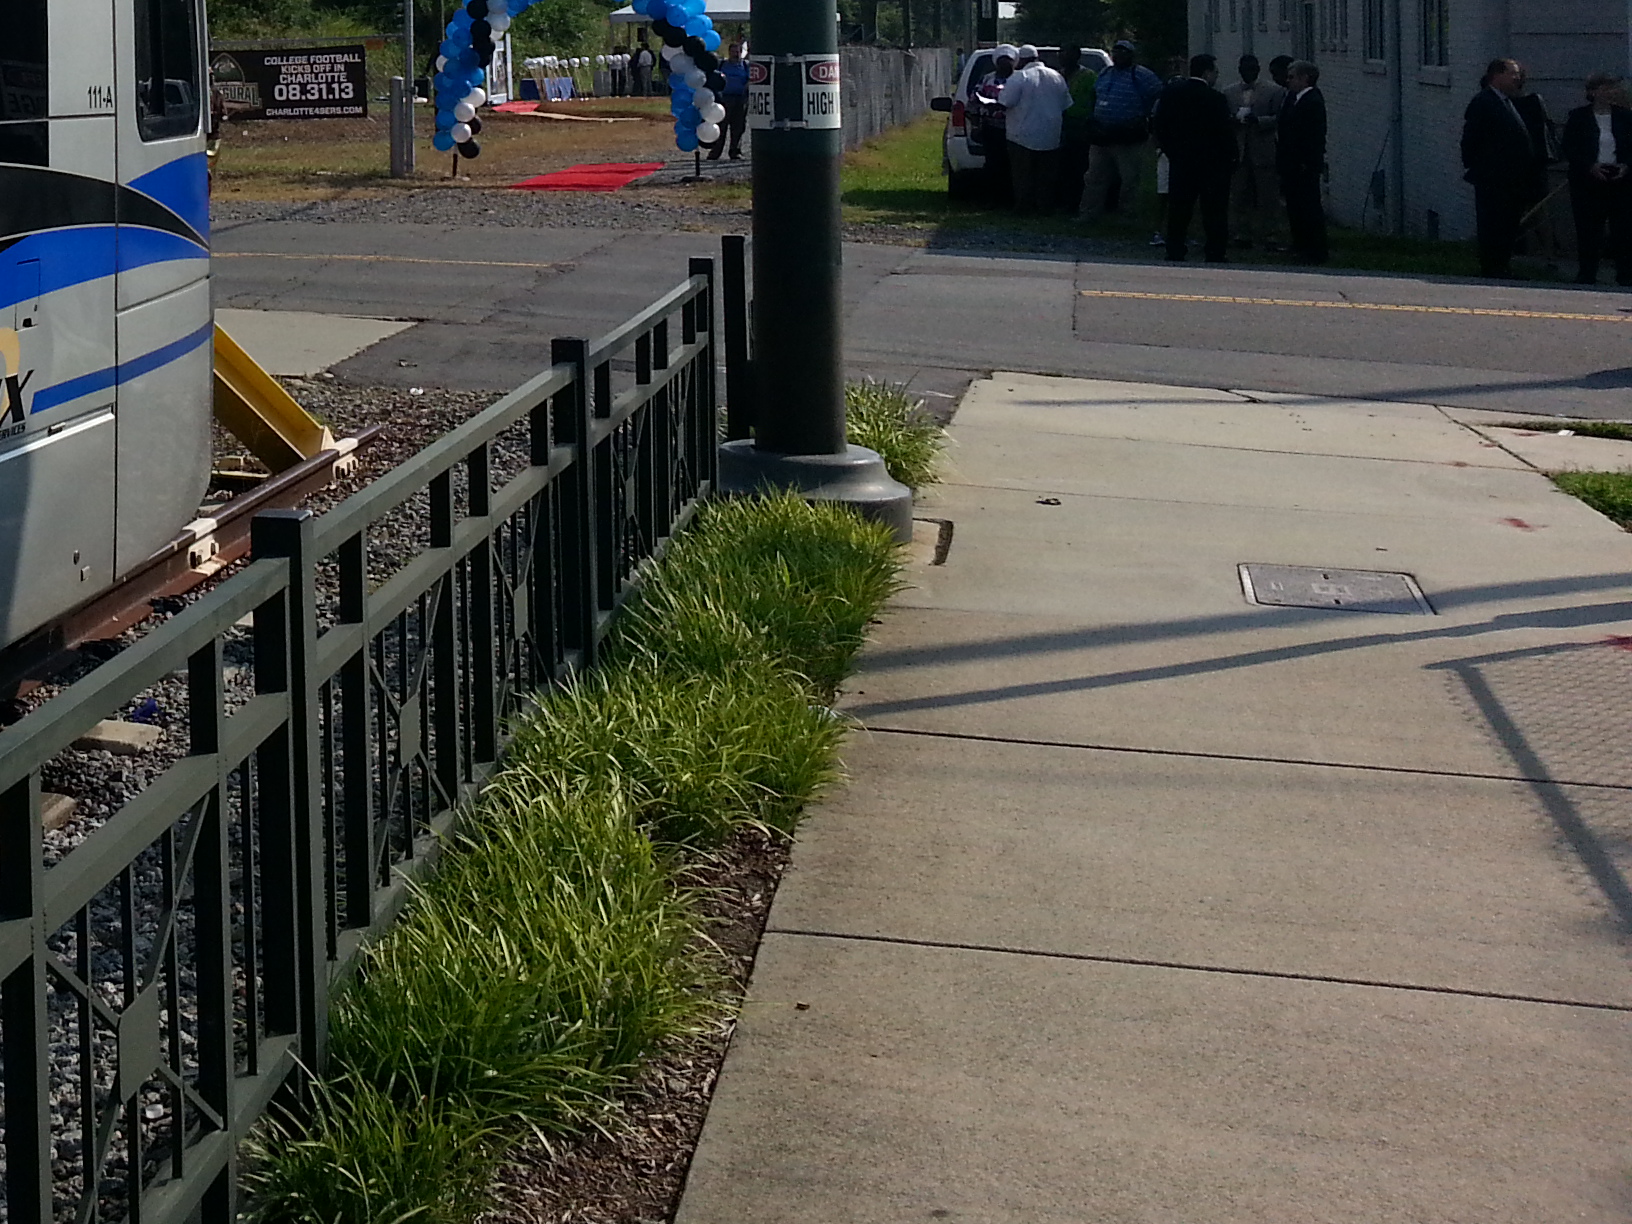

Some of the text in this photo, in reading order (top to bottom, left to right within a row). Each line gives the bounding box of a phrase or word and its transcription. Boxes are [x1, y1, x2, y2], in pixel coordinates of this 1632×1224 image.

[264, 53, 361, 66] COLLEGE FOOTBALL
[281, 63, 345, 74] KICKS OFF IN
[279, 72, 347, 84] CHARLOTTE
[87, 85, 113, 109] 111-A
[274, 82, 354, 101] 08.31.13
[807, 91, 834, 115] HIGH
[266, 106, 363, 116] CHARLOTTE49ERS.COM
